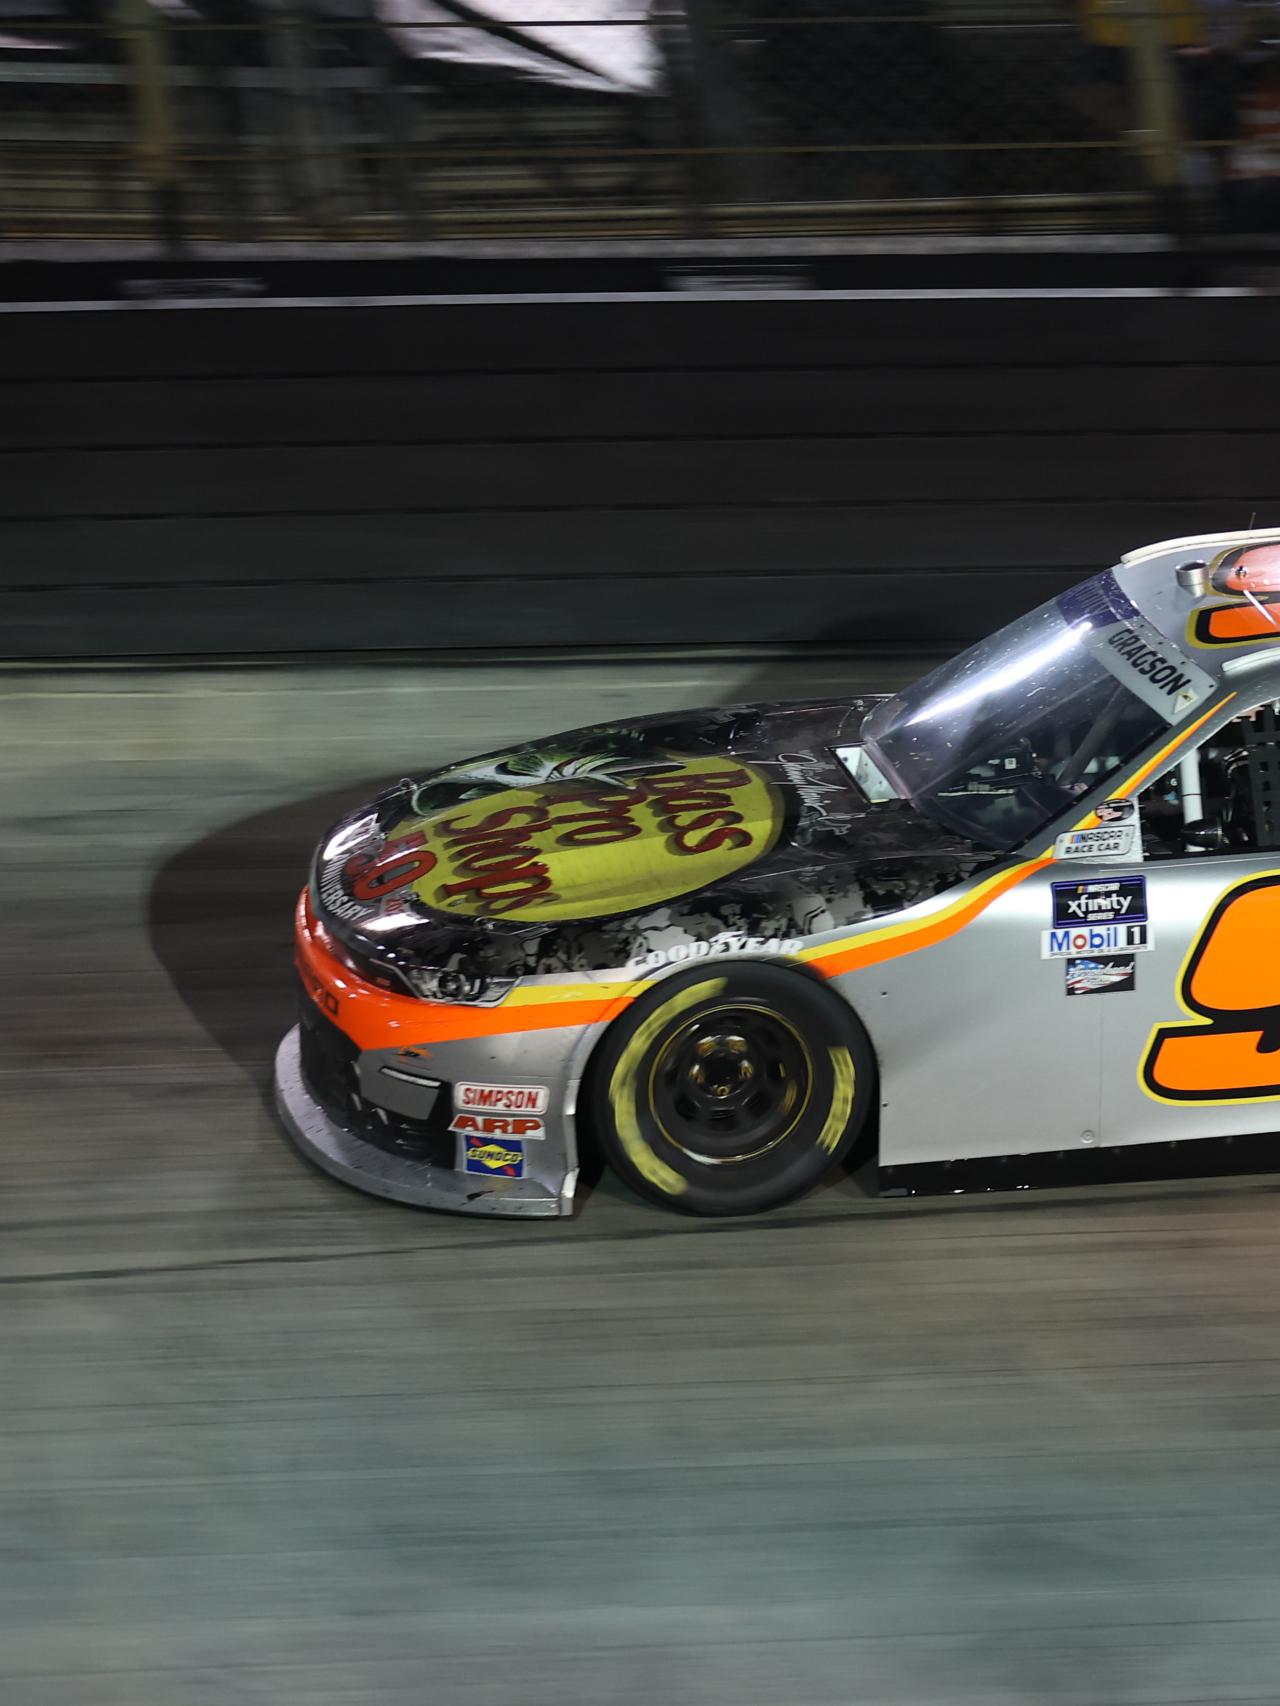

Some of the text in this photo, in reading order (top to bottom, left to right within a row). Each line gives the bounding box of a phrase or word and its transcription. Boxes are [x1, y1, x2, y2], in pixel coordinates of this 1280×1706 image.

[1107, 627, 1192, 697] GRAGSON
[536, 780, 649, 847] Pro
[636, 769, 754, 856] Bass
[432, 805, 558, 917] Shops
[1064, 842, 1121, 855] RACE CAR
[1067, 893, 1133, 918] xfinity
[626, 934, 804, 969] GOODYEAR
[1050, 926, 1118, 953] Mobil
[1130, 926, 1141, 946] 1
[462, 1087, 539, 1109] SIMPSON
[453, 1115, 542, 1135] ARP
[469, 1148, 520, 1163] SUNOCO
